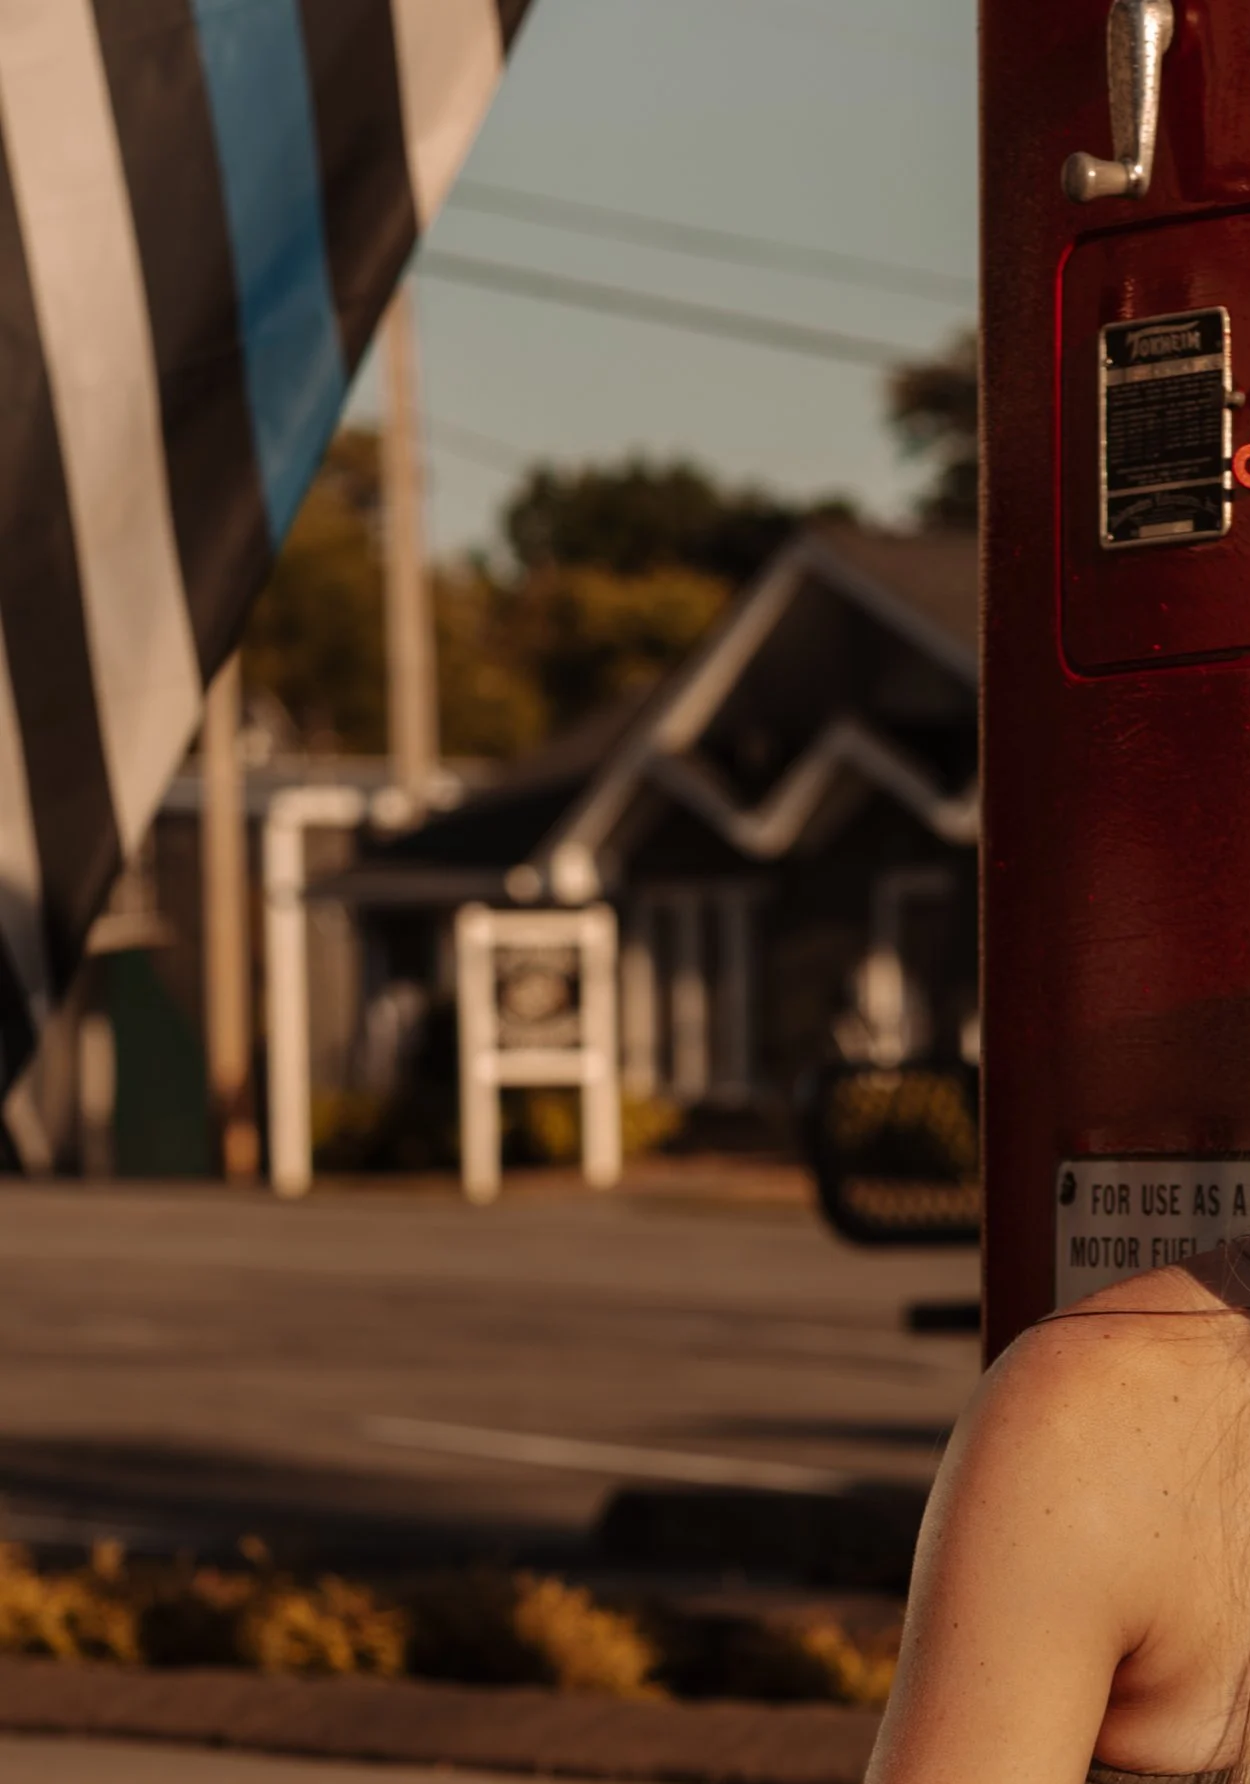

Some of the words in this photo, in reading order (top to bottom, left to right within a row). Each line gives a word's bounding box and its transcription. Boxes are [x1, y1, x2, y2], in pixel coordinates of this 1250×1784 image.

[1090, 1183, 1131, 1217] FOR
[1141, 1183, 1182, 1217] USE
[1191, 1183, 1221, 1217] AS
[1232, 1183, 1247, 1217] A
[1069, 1235, 1141, 1269] MOTOR
